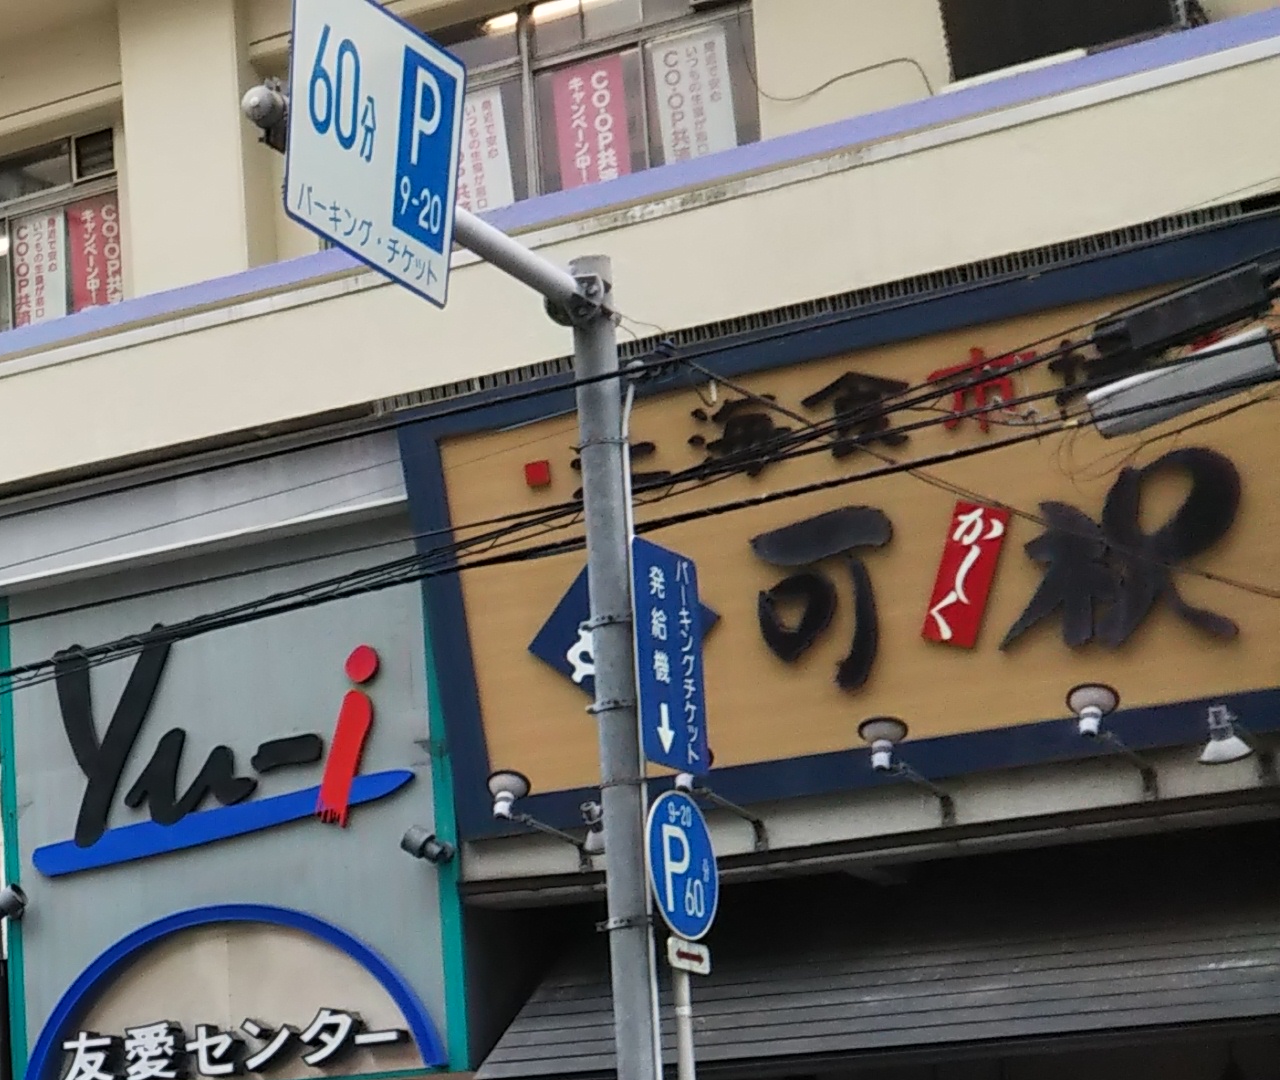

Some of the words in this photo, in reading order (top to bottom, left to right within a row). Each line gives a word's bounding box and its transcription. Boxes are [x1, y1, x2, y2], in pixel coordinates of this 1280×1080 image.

[309, 23, 376, 163] 60分
[409, 66, 441, 166] P
[296, 183, 438, 287] パーキング・チケット
[399, 174, 441, 236] 9-20
[648, 565, 670, 685] 発給機
[929, 506, 1006, 642] かしく
[674, 560, 699, 766] パーキングチケット
[667, 800, 692, 828] 9-20
[662, 823, 690, 913] P
